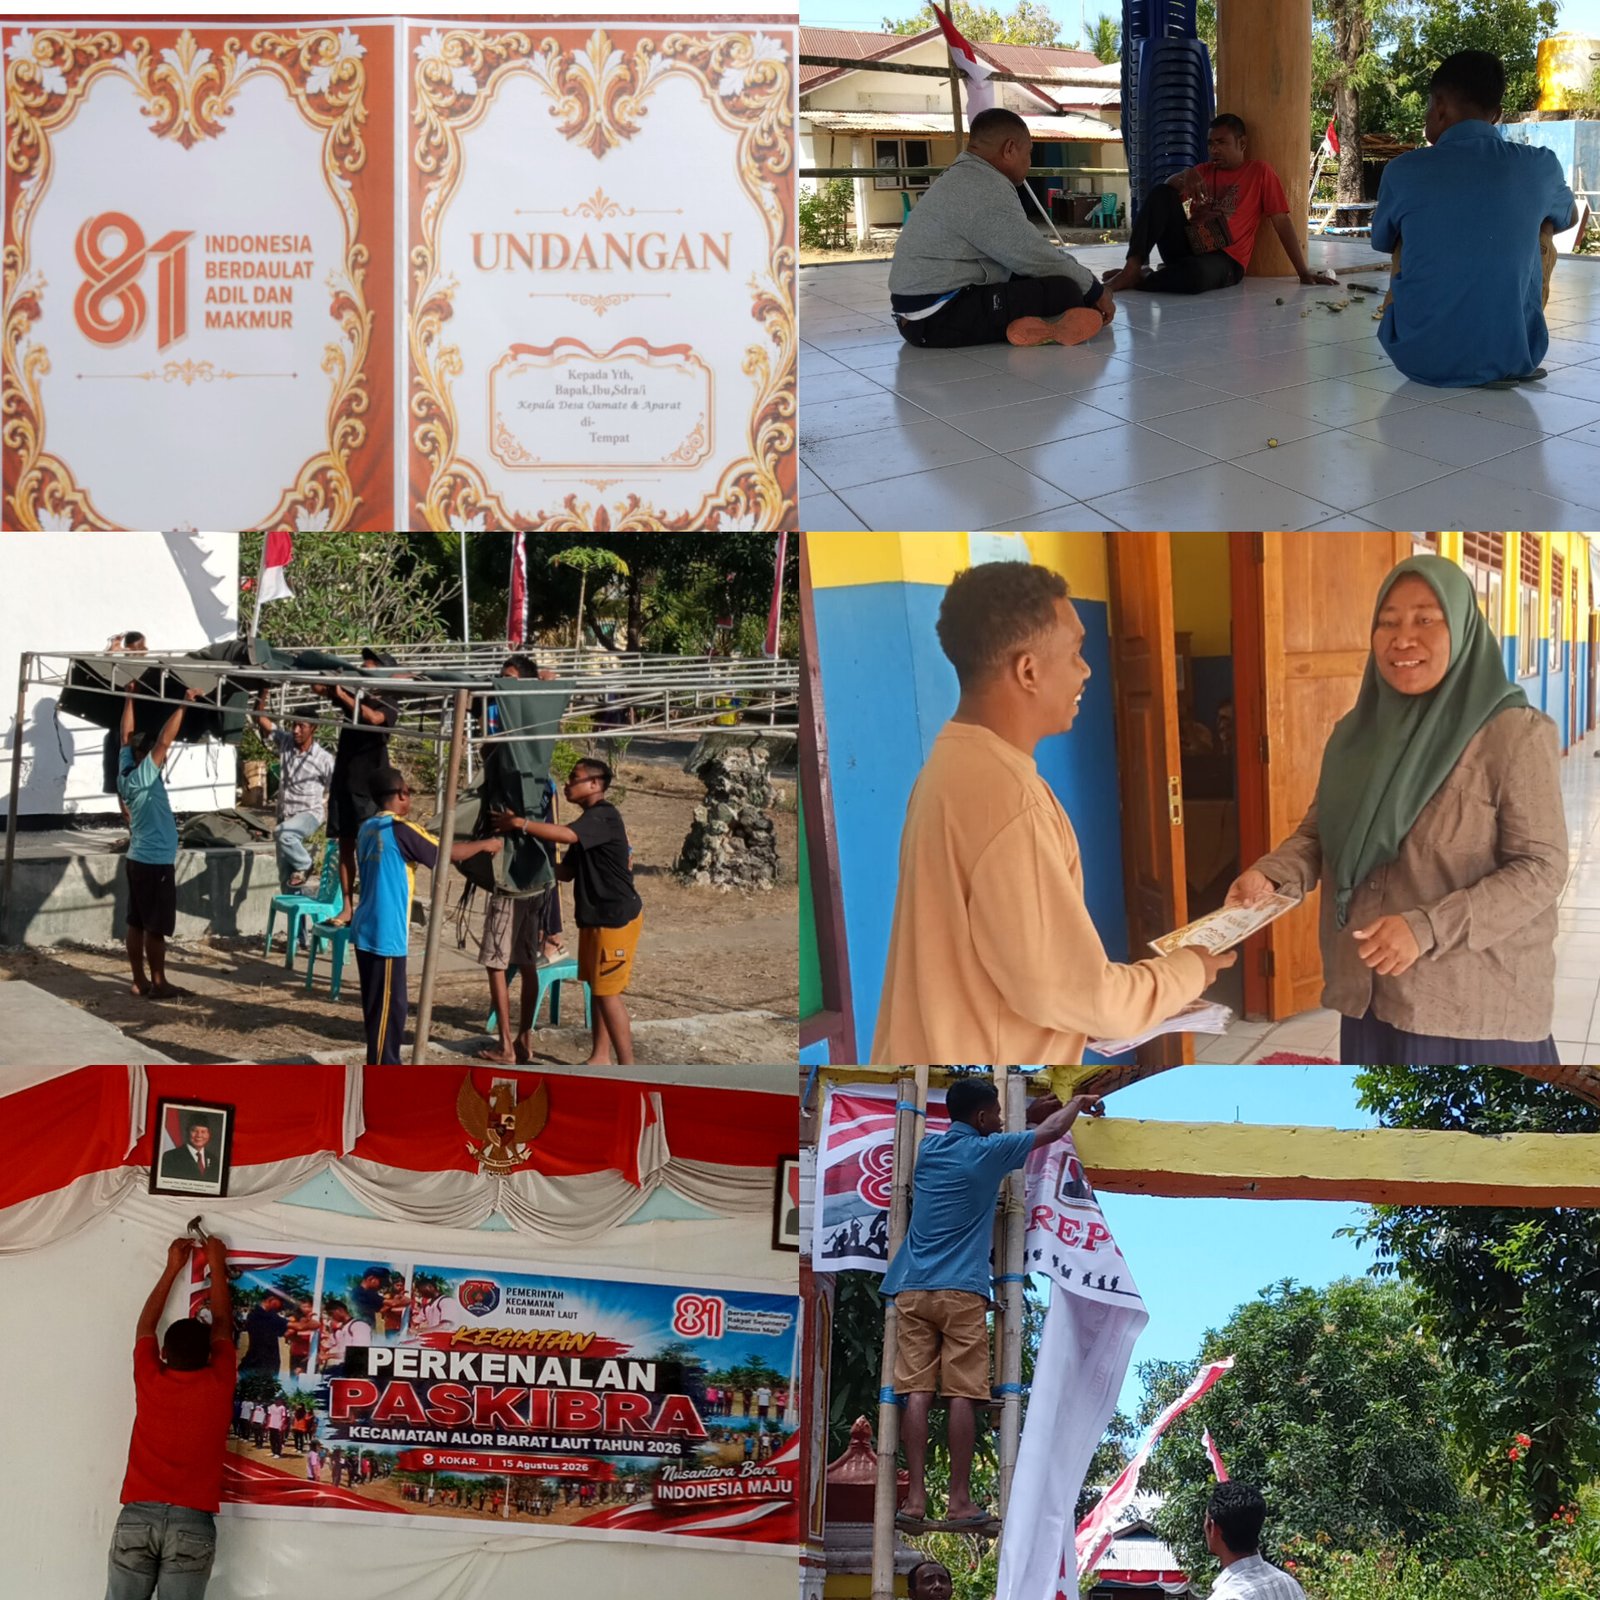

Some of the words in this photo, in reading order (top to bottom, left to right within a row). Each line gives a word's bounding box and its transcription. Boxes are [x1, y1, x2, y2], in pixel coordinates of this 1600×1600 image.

[205, 234, 312, 253] INDONESIA
[470, 232, 732, 272] UNDANGAN
[205, 260, 314, 279] BERDAULAT
[73, 211, 197, 352] 81
[205, 285, 249, 304] ADIL
[253, 285, 293, 304] DAN
[205, 310, 293, 329] MAKMUR
[568, 369, 608, 382] Kepada
[611, 369, 634, 381] Yth,
[517, 400, 555, 412] Kepala
[558, 400, 584, 410] Desa
[630, 401, 639, 410] &
[641, 400, 682, 412] Aparat
[589, 432, 630, 445] Tempat
[1025, 1203, 1123, 1258] REP
[505, 1297, 555, 1309] KECAMATAN
[506, 1287, 564, 1300] PEMERINTAH
[505, 1306, 527, 1317] ALOR
[529, 1308, 555, 1318] BARAT
[557, 1310, 578, 1320] LAUT
[673, 1294, 721, 1337] 81
[450, 1325, 597, 1351] KEGIATAN
[367, 1347, 656, 1392] PERKENALAN
[328, 1378, 709, 1438] PASKIBRA
[349, 1425, 448, 1443] KECAMATAN
[451, 1431, 493, 1446] ALOR
[496, 1434, 549, 1448] BARAT
[551, 1437, 590, 1450] LAUT
[593, 1438, 648, 1452] TAHUN
[648, 1440, 681, 1454] 2026
[502, 1459, 514, 1468] 15
[516, 1459, 560, 1471] Agustus
[561, 1462, 589, 1472] 2026
[661, 1464, 736, 1481] Nusantara
[739, 1460, 777, 1478] Baru
[657, 1481, 744, 1499] INDONESIA
[748, 1479, 793, 1494] MAJU
